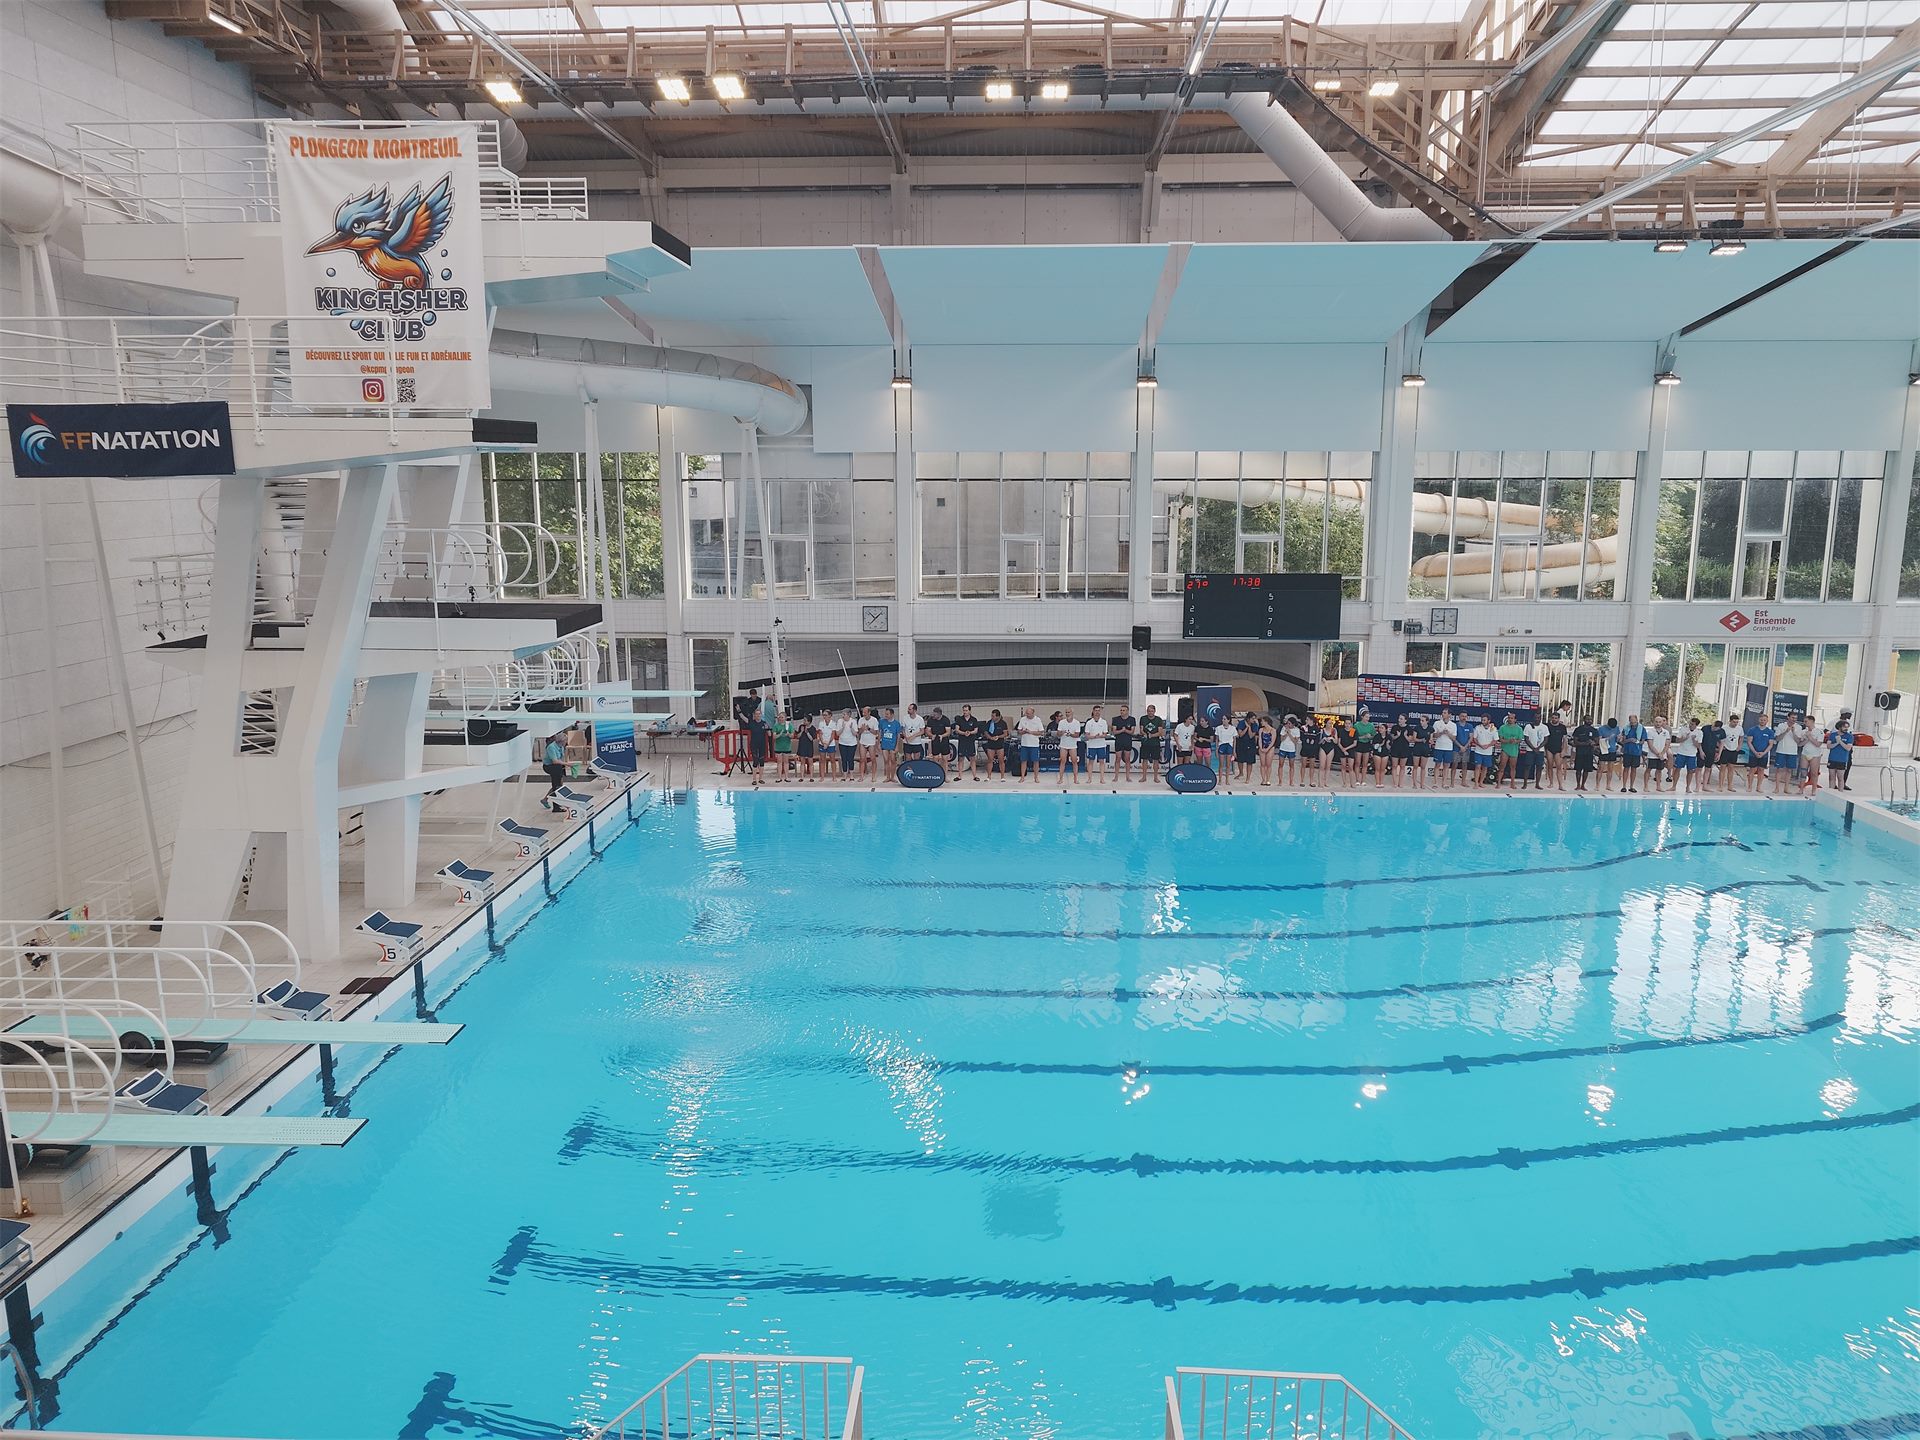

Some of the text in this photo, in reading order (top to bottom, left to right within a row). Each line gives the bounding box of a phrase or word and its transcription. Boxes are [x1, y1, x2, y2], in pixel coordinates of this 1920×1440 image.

[289, 136, 462, 159] PLONGEON MONTREUIL
[316, 288, 467, 310] KINGFISHER
[359, 318, 426, 341] CLUB
[305, 350, 342, 361] DÉCOUVREZ
[343, 351, 351, 361] LE
[352, 351, 371, 361] SPORT
[374, 351, 385, 361] QUI
[406, 351, 419, 361] FUN
[421, 351, 429, 361] ET
[431, 350, 472, 361] ADRÉNALINE
[60, 428, 221, 450] FFNATATION
[1753, 617, 1796, 625] Ensemble
[609, 742, 633, 751] FRANCE
[1406, 766, 1412, 775] 2
[611, 779, 616, 788] 1
[570, 809, 578, 818] 2
[522, 846, 530, 855] 3
[463, 890, 472, 901] 4
[387, 948, 396, 960] 5
